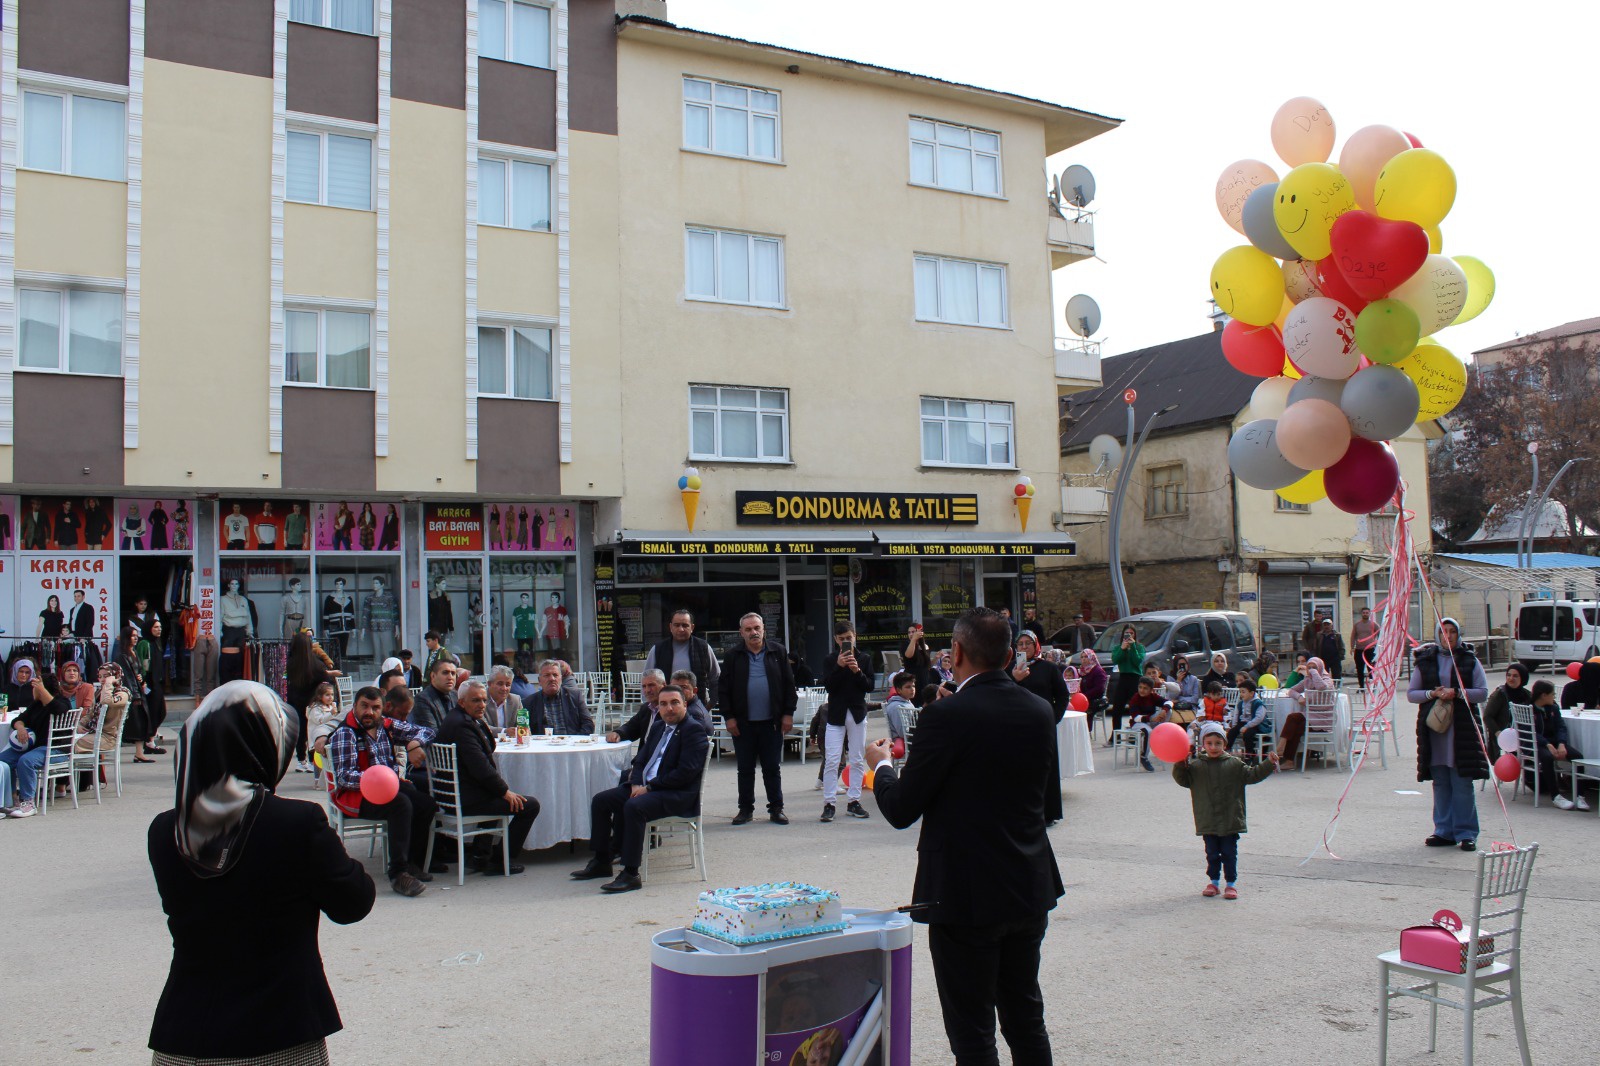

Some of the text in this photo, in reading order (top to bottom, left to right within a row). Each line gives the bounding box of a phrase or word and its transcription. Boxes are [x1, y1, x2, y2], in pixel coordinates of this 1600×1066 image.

[437, 508, 471, 518] KARACA
[776, 496, 949, 519] DONDURMA & TATLI
[429, 521, 447, 531] BAY
[450, 521, 480, 531] BAYAN
[439, 534, 470, 546] GİYİM
[641, 541, 676, 554] İSMAİL
[681, 543, 708, 554] USTA
[714, 543, 769, 554] DONDURMA
[774, 543, 782, 553] &
[788, 543, 814, 553] TATLI
[889, 543, 918, 555] İSMAİL
[923, 545, 945, 555] USTA
[950, 545, 995, 554] DONDURMA
[1000, 545, 1006, 554] &
[1011, 545, 1033, 554] TATLI
[30, 559, 104, 574] KARACA
[41, 577, 95, 591] GİYİM
[858, 584, 906, 603] İSMAİL USTA
[924, 583, 970, 601] İSMAİL USTA
